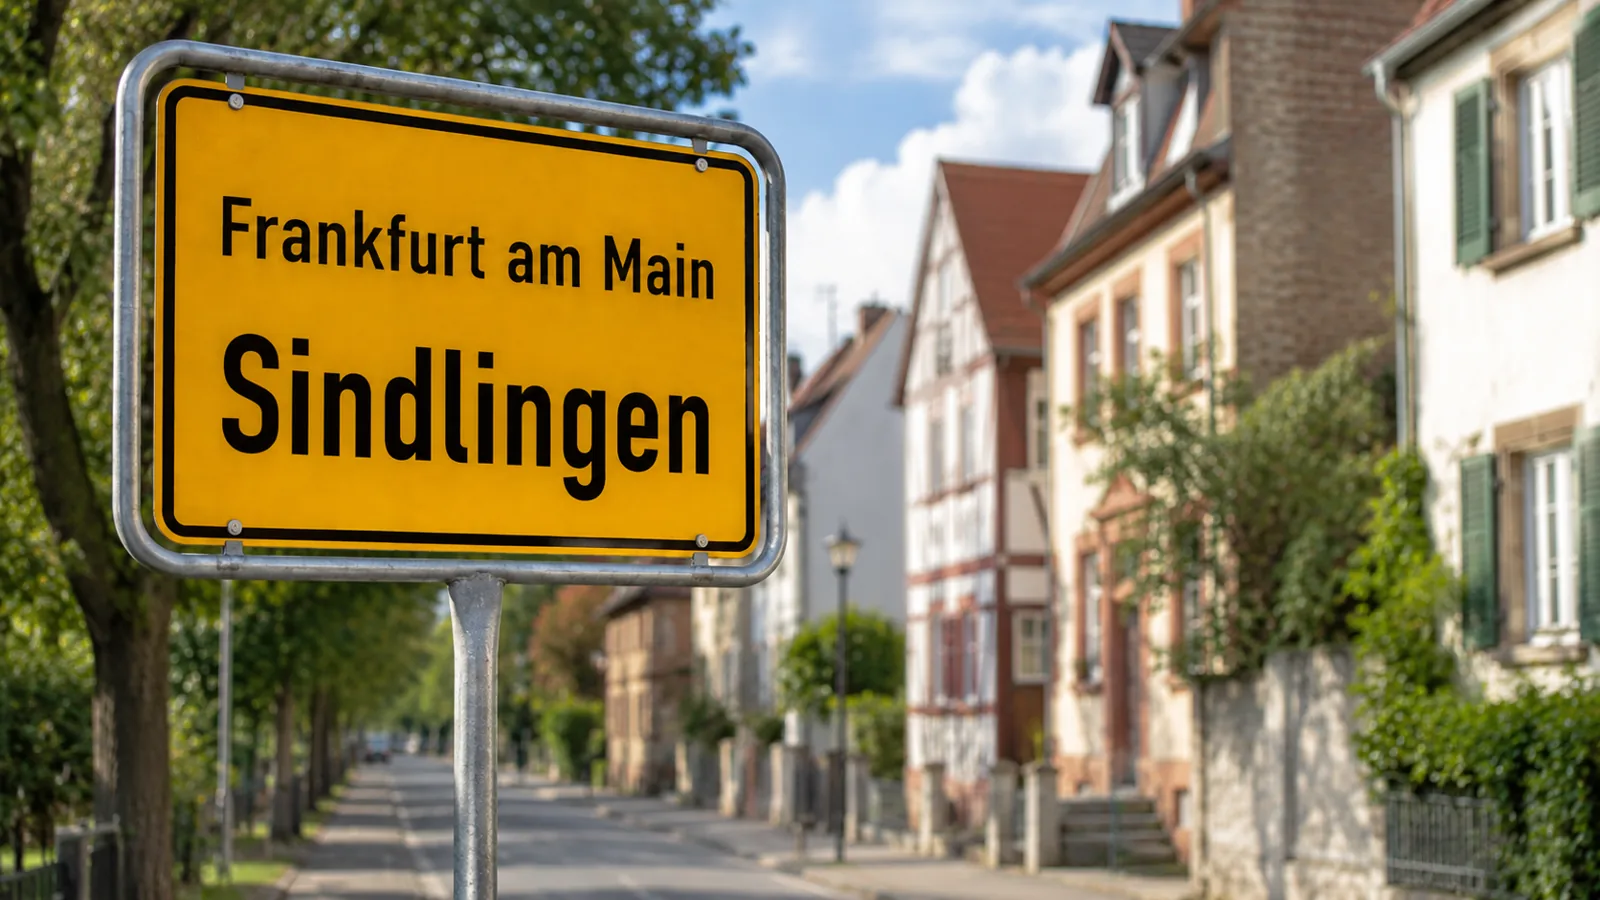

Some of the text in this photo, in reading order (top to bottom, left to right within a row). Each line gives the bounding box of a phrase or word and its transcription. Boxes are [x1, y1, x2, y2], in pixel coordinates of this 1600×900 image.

[222, 196, 714, 299] Frankfurt am Main
[222, 334, 710, 501] Sindlingen
